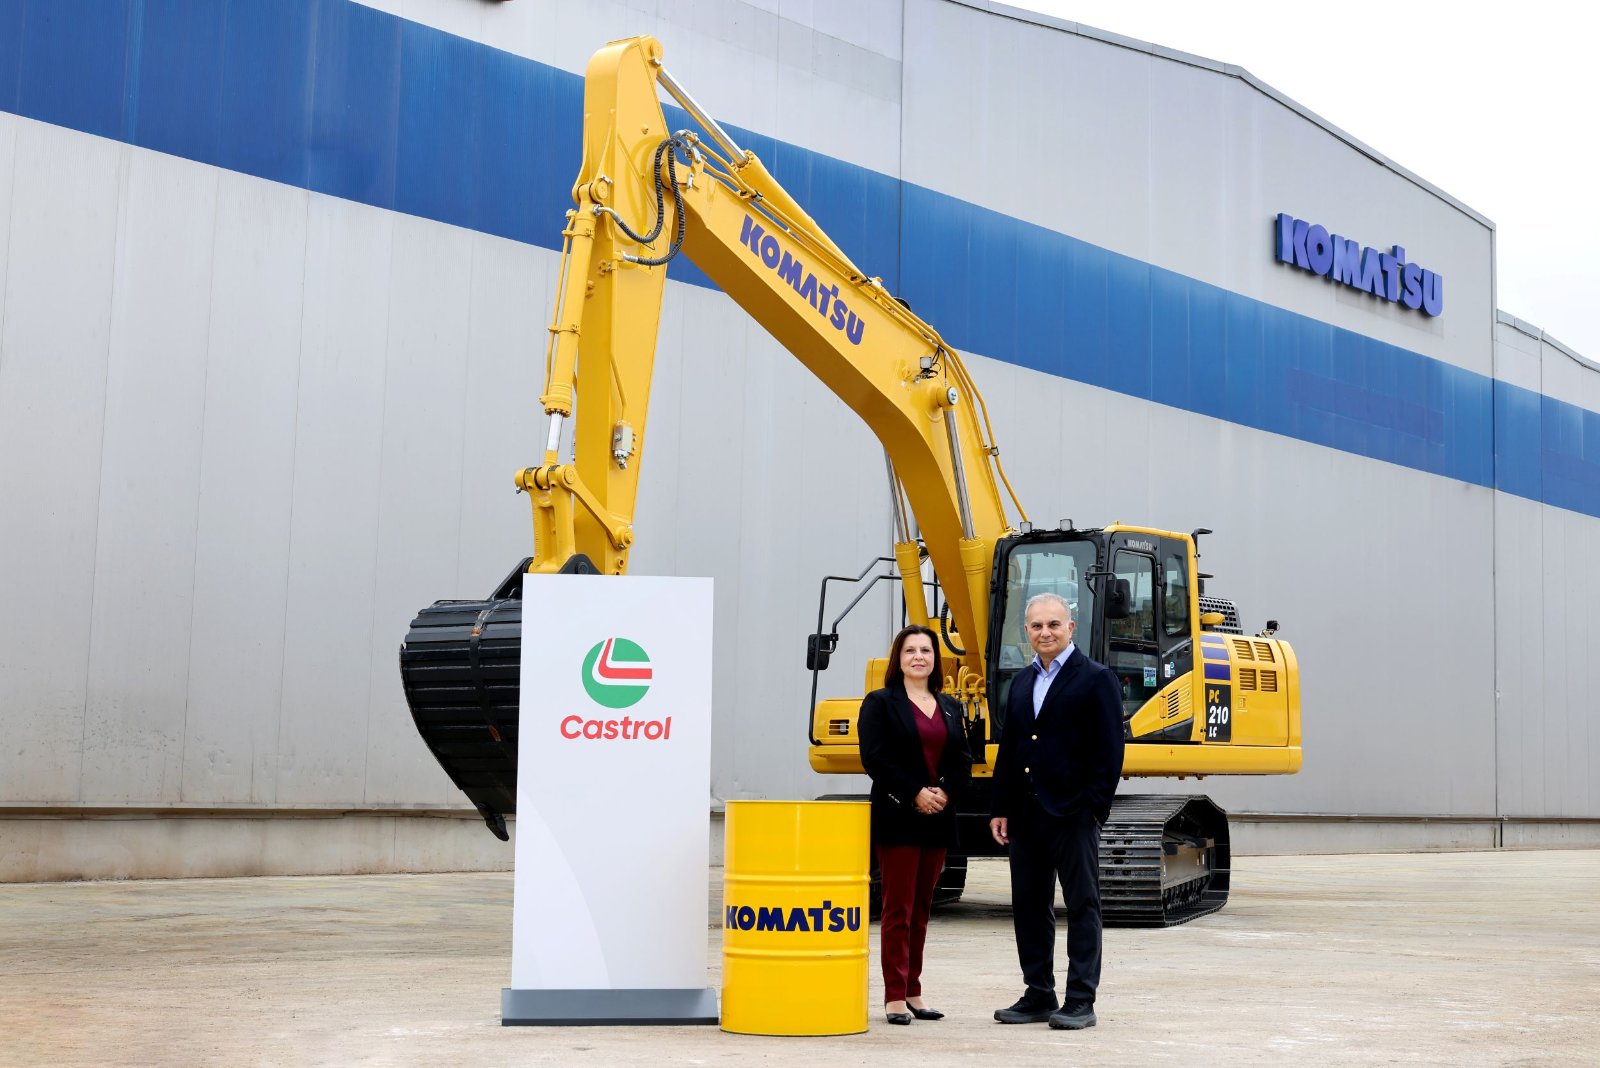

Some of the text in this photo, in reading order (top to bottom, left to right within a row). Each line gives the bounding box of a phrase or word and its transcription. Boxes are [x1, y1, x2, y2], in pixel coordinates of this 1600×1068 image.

[1276, 212, 1443, 318] KOMATSU
[740, 214, 865, 345] KOMATSU
[1208, 689, 1220, 703] PC
[560, 714, 672, 741] Castrol
[1208, 705, 1229, 724] 210
[1208, 726, 1218, 738] LC
[726, 900, 861, 933] KOMATSU
